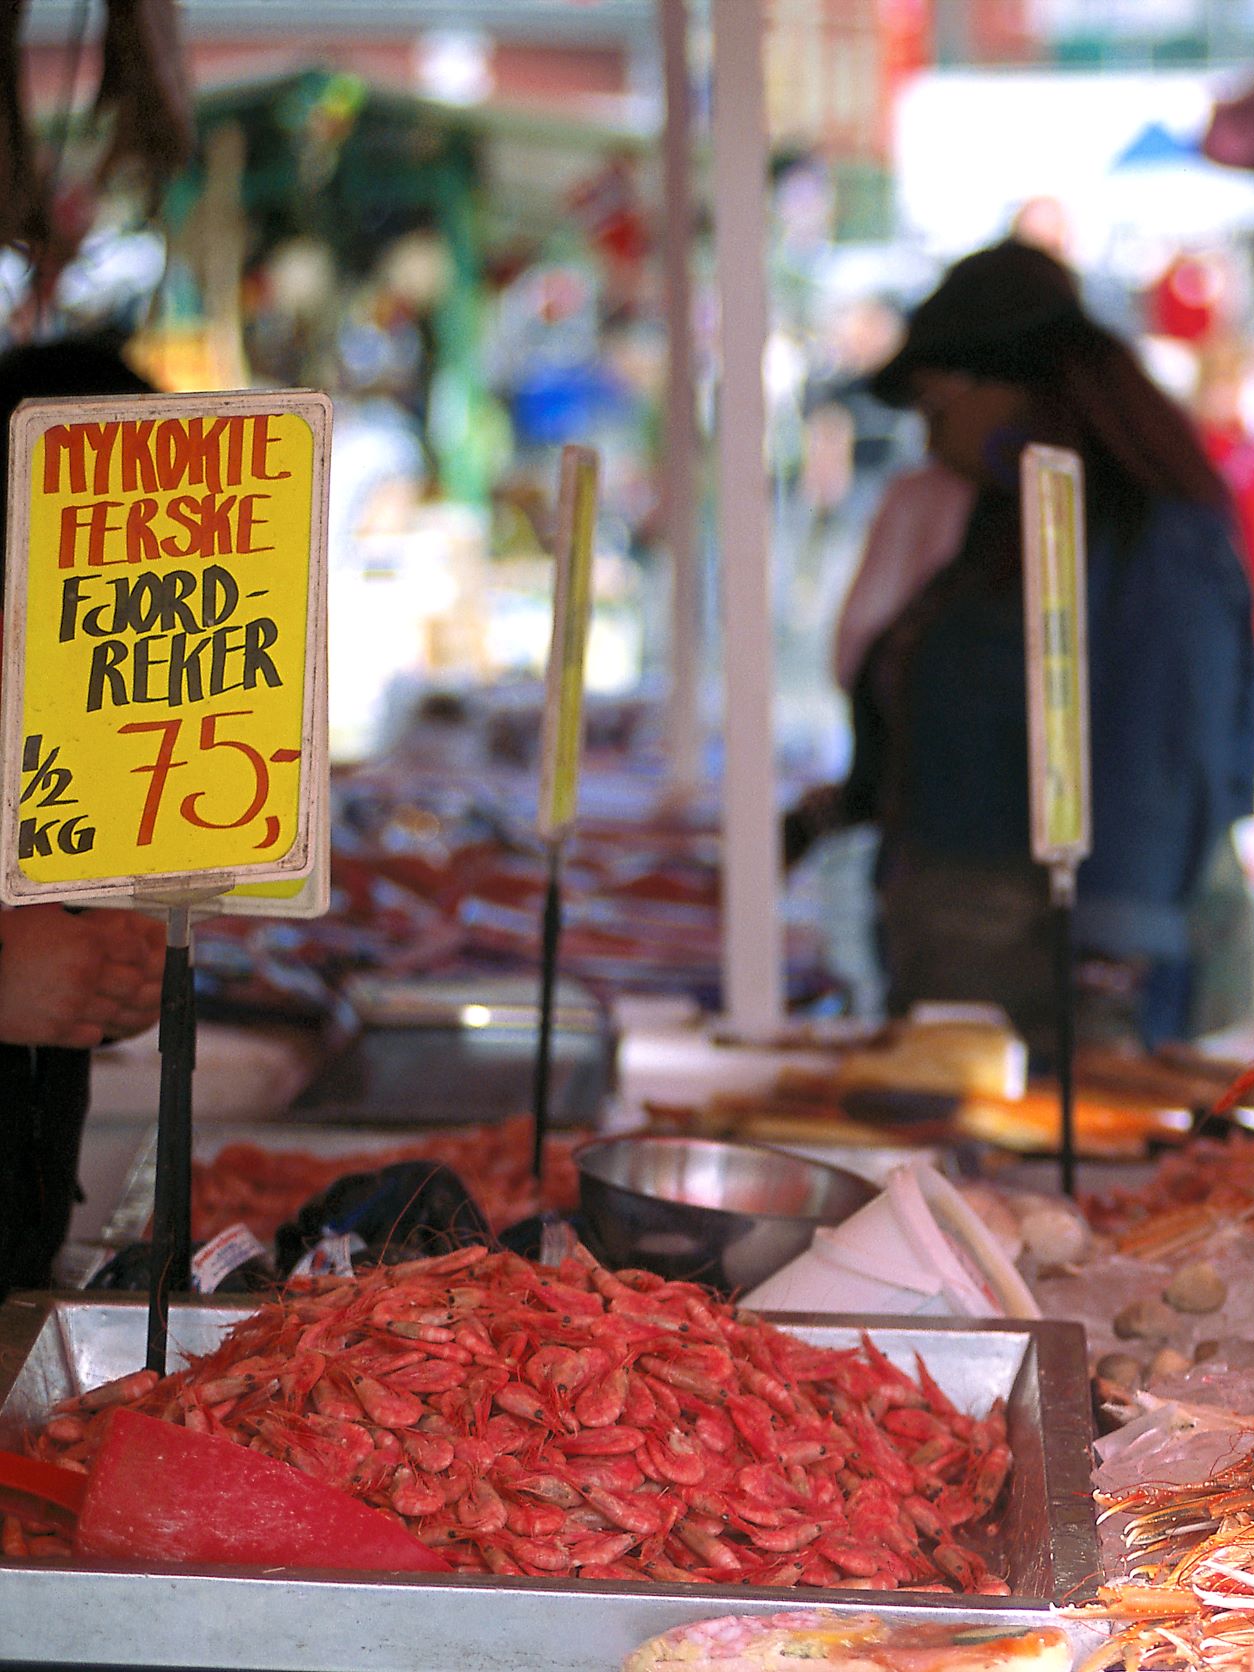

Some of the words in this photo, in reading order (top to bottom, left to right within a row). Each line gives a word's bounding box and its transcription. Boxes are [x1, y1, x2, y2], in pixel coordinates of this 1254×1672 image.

[58, 493, 275, 569] FERSKE
[59, 564, 270, 643] FJORD-
[86, 617, 284, 713] REKER
[18, 814, 97, 860] KG
